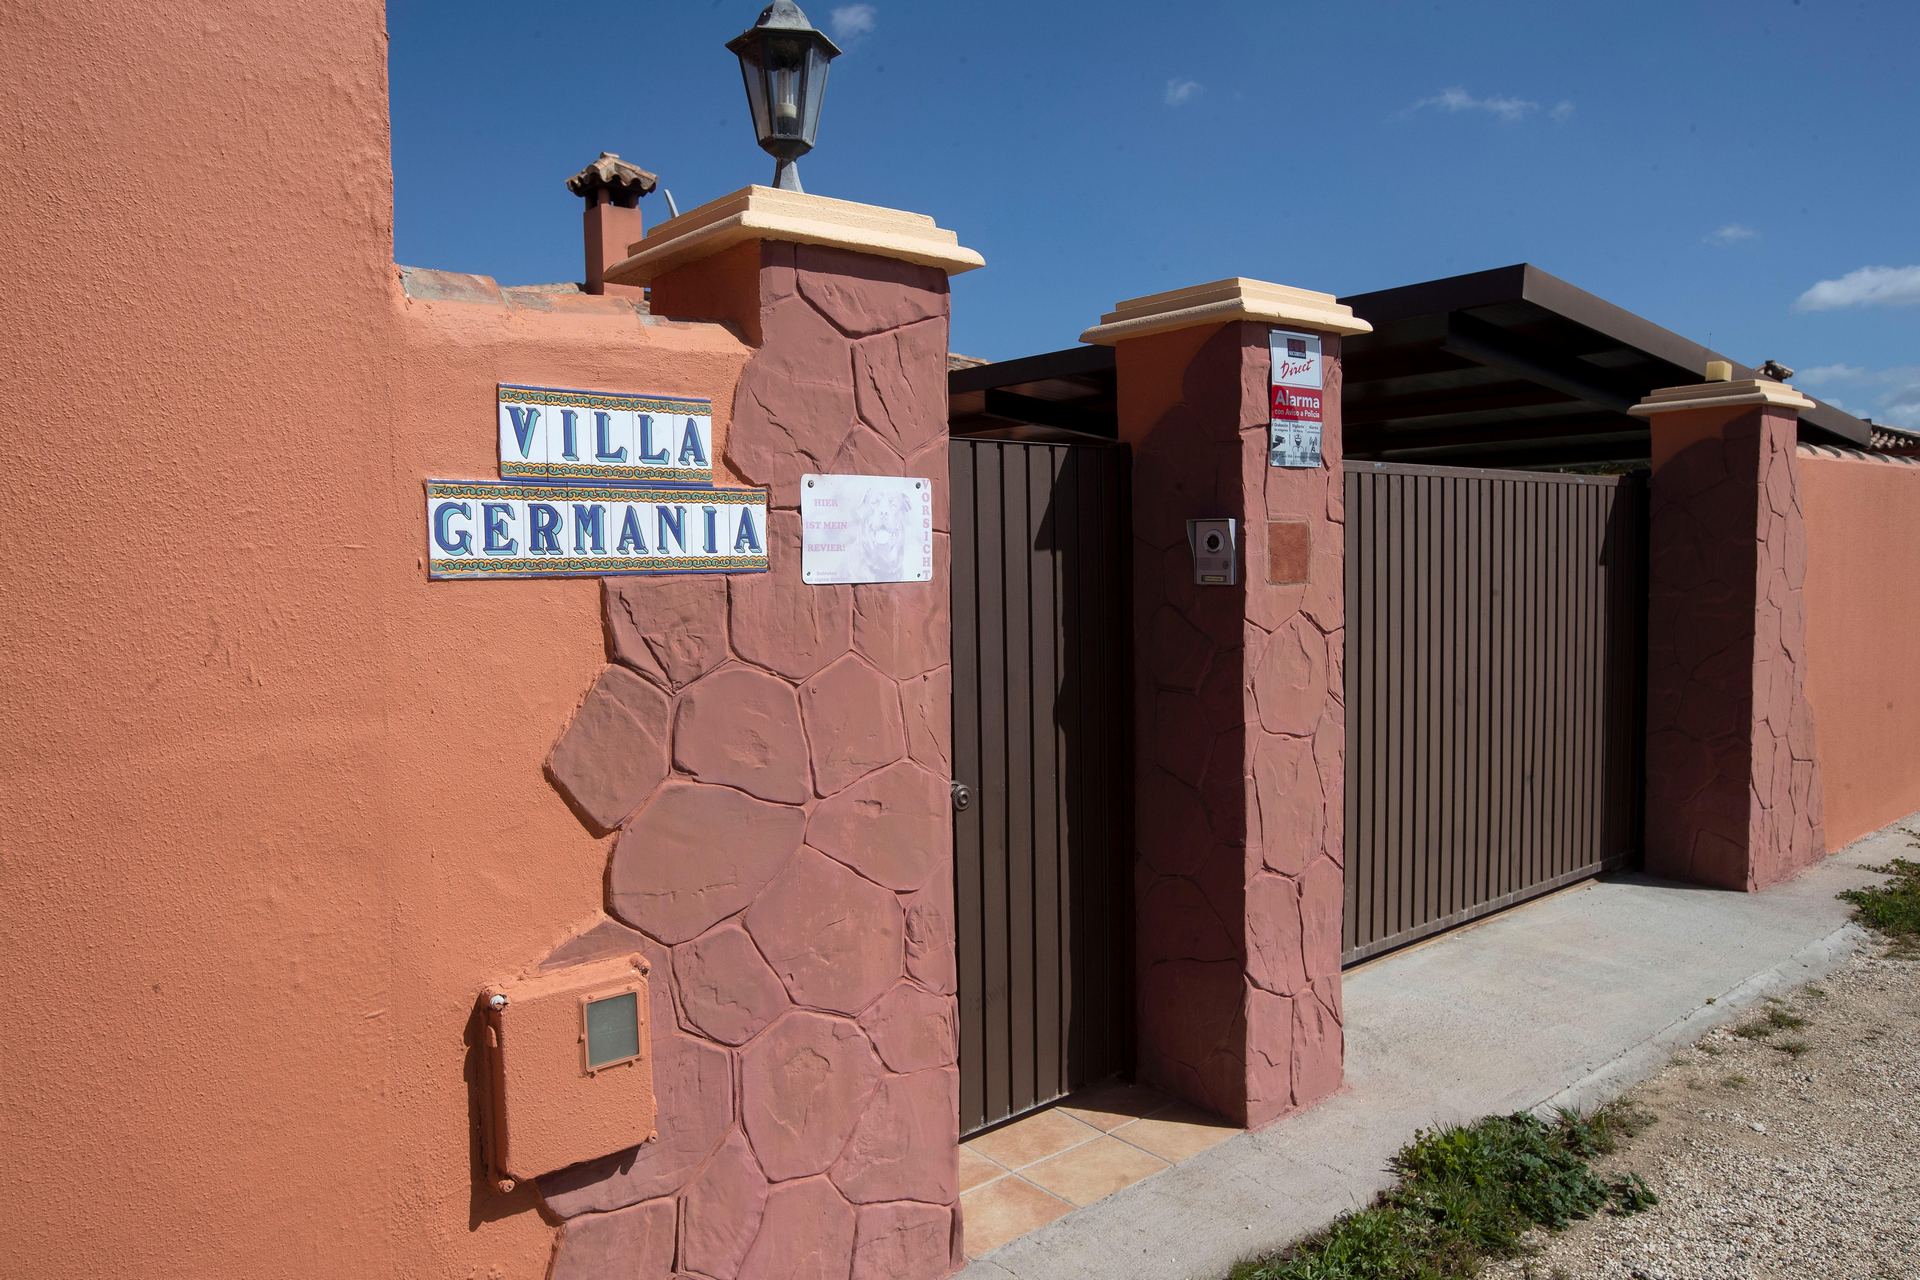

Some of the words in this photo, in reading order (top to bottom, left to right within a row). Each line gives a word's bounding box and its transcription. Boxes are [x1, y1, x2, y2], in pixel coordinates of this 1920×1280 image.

[1280, 358, 1315, 380] Direct
[1274, 389, 1320, 409] Alarma
[1285, 409, 1299, 417] Aviso
[505, 405, 709, 467] VILLA
[814, 498, 839, 507] HIER
[433, 501, 763, 557] GERMANIA
[805, 521, 821, 530] IST
[823, 521, 848, 530] MEIN
[921, 479, 931, 579] VORSICHT
[807, 543, 846, 552] REVIER!
